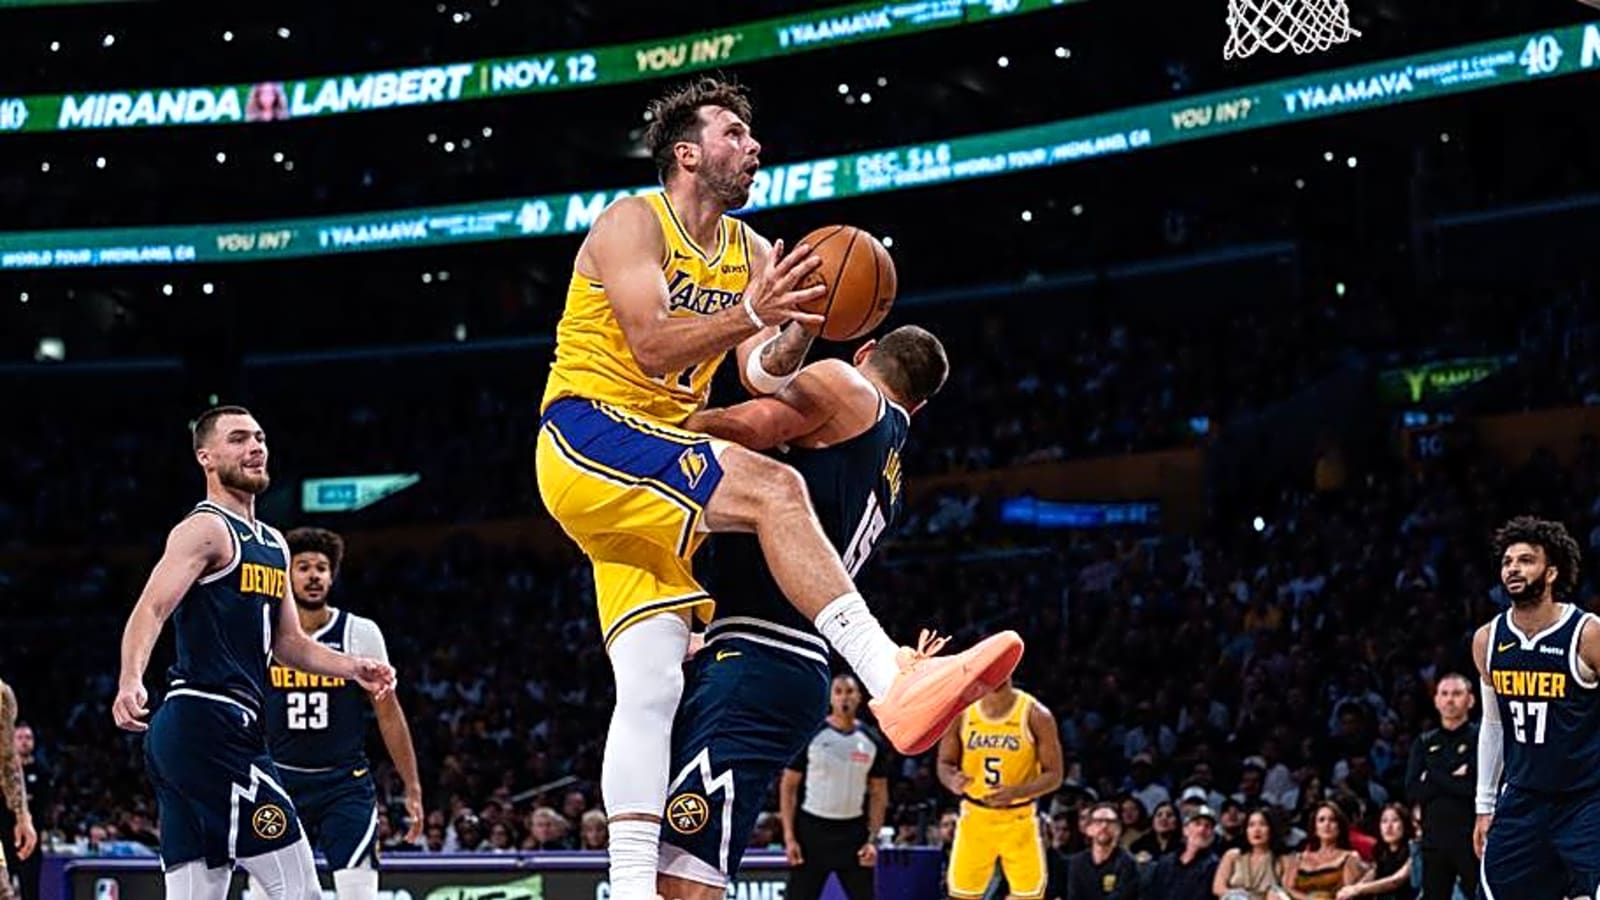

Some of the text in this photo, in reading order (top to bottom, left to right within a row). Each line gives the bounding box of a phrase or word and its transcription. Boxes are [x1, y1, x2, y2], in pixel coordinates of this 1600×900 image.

[636, 34, 735, 72] YOU IN?
[1519, 35, 1563, 76] 40
[491, 54, 597, 90] NOV. 12
[57, 64, 472, 129] MIRANDA LAMBERT
[1171, 98, 1252, 130] YOU IN?
[747, 159, 838, 207] RIFE
[856, 151, 903, 178] DEC.
[217, 229, 292, 251] YOU IN?
[842, 489, 886, 580] 15
[240, 562, 287, 599] DENVE
[1491, 669, 1566, 698] DENVER
[286, 691, 329, 730] 23
[1508, 700, 1549, 744] 27
[967, 730, 1020, 751] LAKERS
[983, 757, 1001, 786] 5
